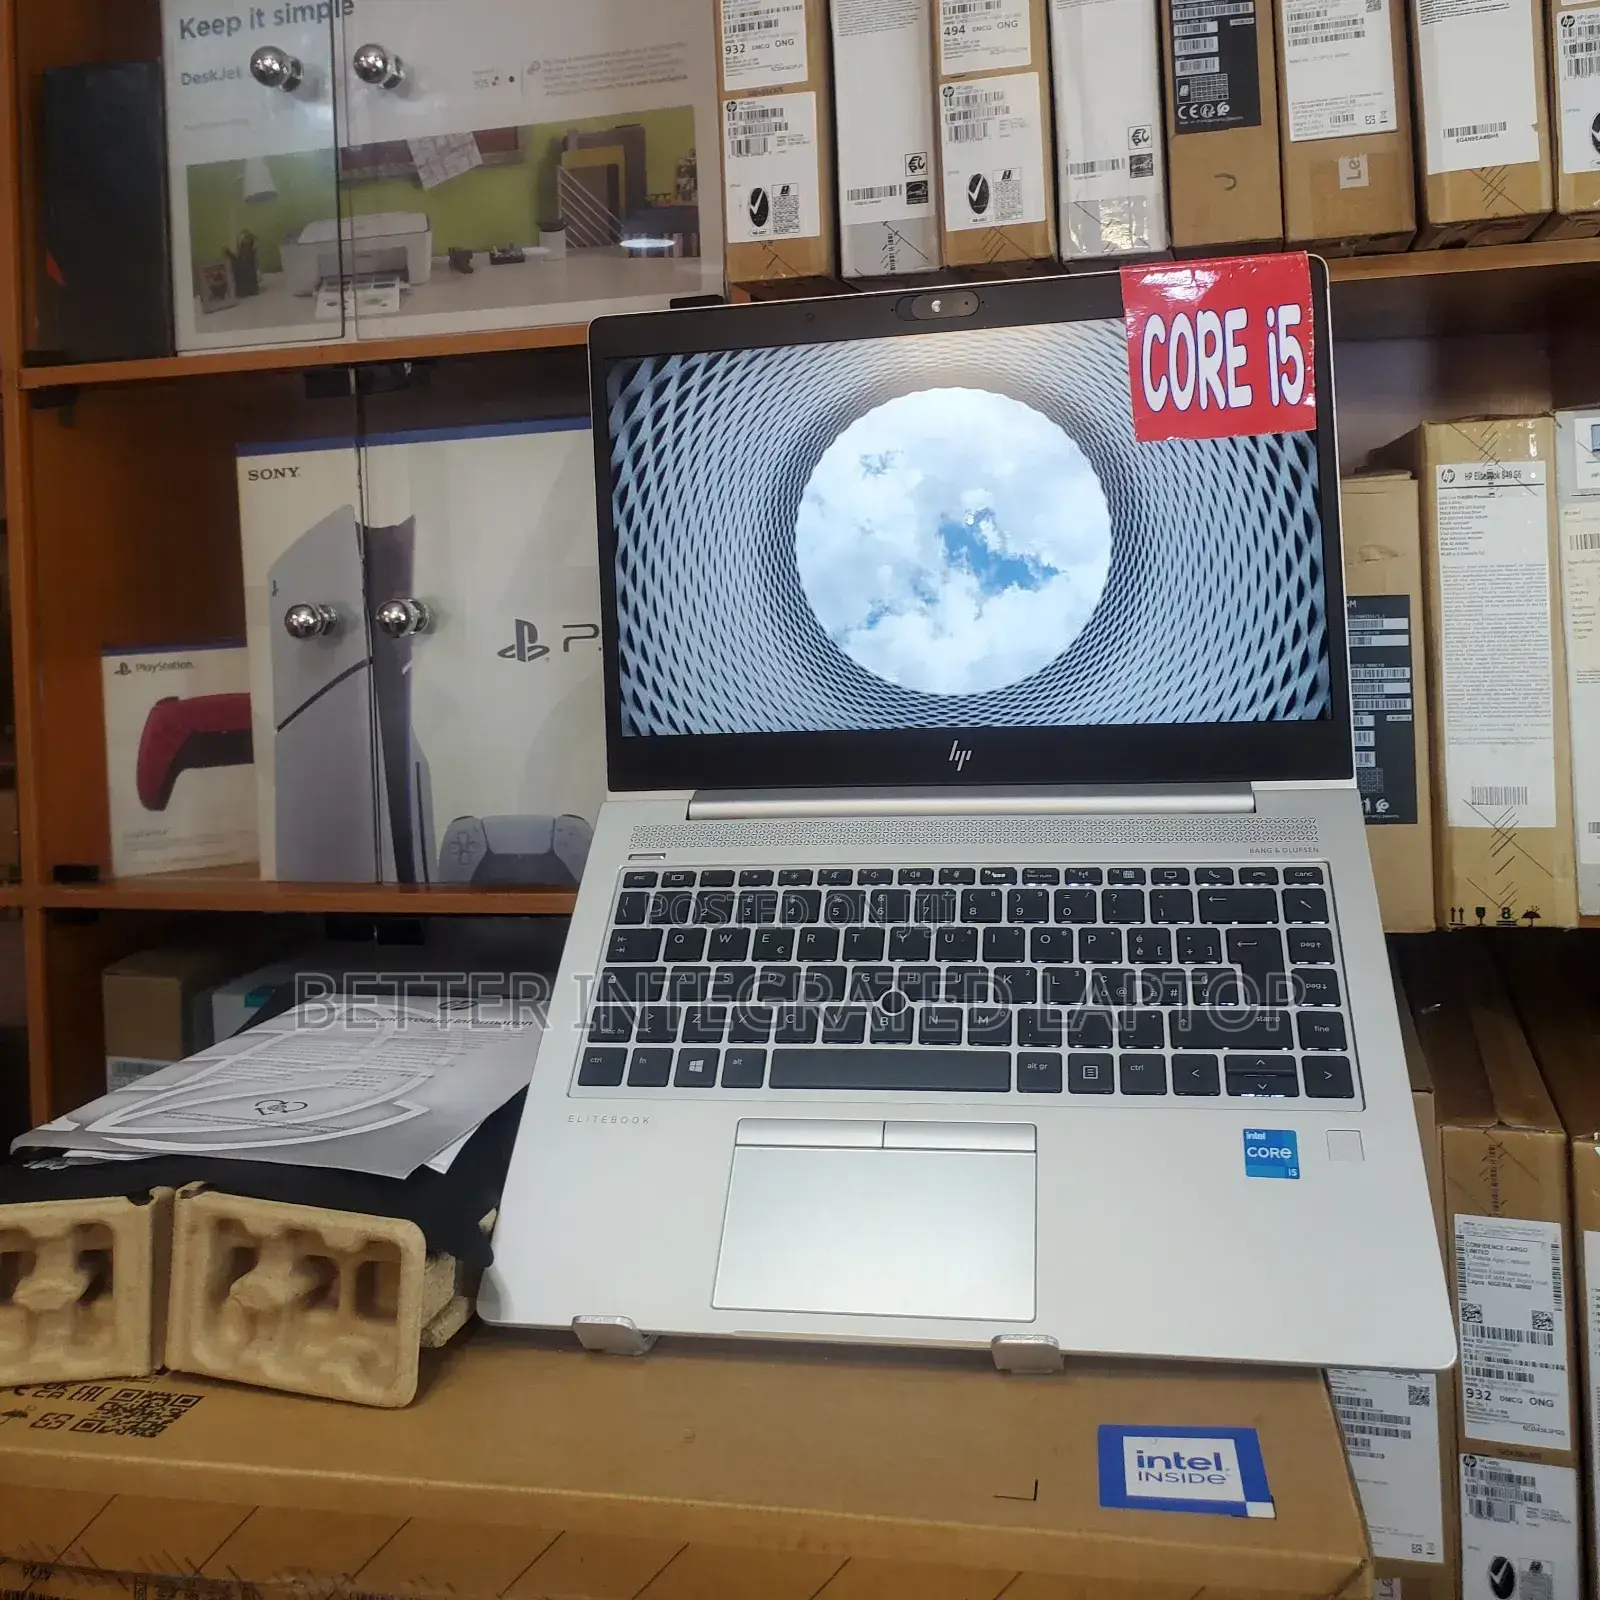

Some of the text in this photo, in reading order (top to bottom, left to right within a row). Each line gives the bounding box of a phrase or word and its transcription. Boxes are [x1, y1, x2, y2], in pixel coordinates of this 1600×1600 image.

[179, 0, 355, 39] Keep it simple
[943, 24, 966, 36] 494
[997, 20, 1018, 29] ONG
[725, 43, 746, 55] 932
[775, 38, 795, 48] ONG
[181, 66, 243, 86] DeskJet
[1141, 303, 1305, 412] CORE i5
[248, 466, 300, 481] SONY
[136, 660, 194, 674] PlayStation
[743, 908, 751, 916] 3
[788, 907, 795, 916] 4
[832, 907, 840, 916] 5
[969, 907, 977, 916] 8
[1016, 907, 1024, 916] 9
[674, 934, 685, 944] Q
[719, 934, 732, 943] W
[762, 934, 771, 943] E
[806, 934, 816, 943] R
[851, 934, 860, 943] T
[899, 934, 907, 943] Y
[945, 934, 954, 943] U
[1088, 935, 1096, 944] P
[678, 973, 688, 982] A
[722, 973, 732, 982] S
[768, 973, 777, 982] D
[860, 973, 870, 982] G
[907, 973, 917, 982] H
[955, 973, 962, 983] J
[1003, 974, 1013, 984] K
[1052, 975, 1060, 985] L
[692, 1014, 701, 1023] Z
[738, 1014, 747, 1023] X
[785, 1014, 795, 1024] C
[832, 1014, 842, 1024] V
[880, 1017, 888, 1027] B
[929, 1016, 938, 1025] N
[978, 1016, 989, 1025] M
[1256, 1015, 1281, 1024] stamp
[1314, 1025, 1330, 1033] fine
[590, 1056, 602, 1064] ctrl
[732, 1058, 743, 1066] alt
[1027, 1062, 1048, 1071] alt gr
[567, 1114, 651, 1125] ELITEBOOK
[1246, 1131, 1266, 1141] intel
[1465, 1387, 1492, 1401] 932
[1529, 1397, 1555, 1408] ONG
[1136, 1449, 1223, 1472] intel
